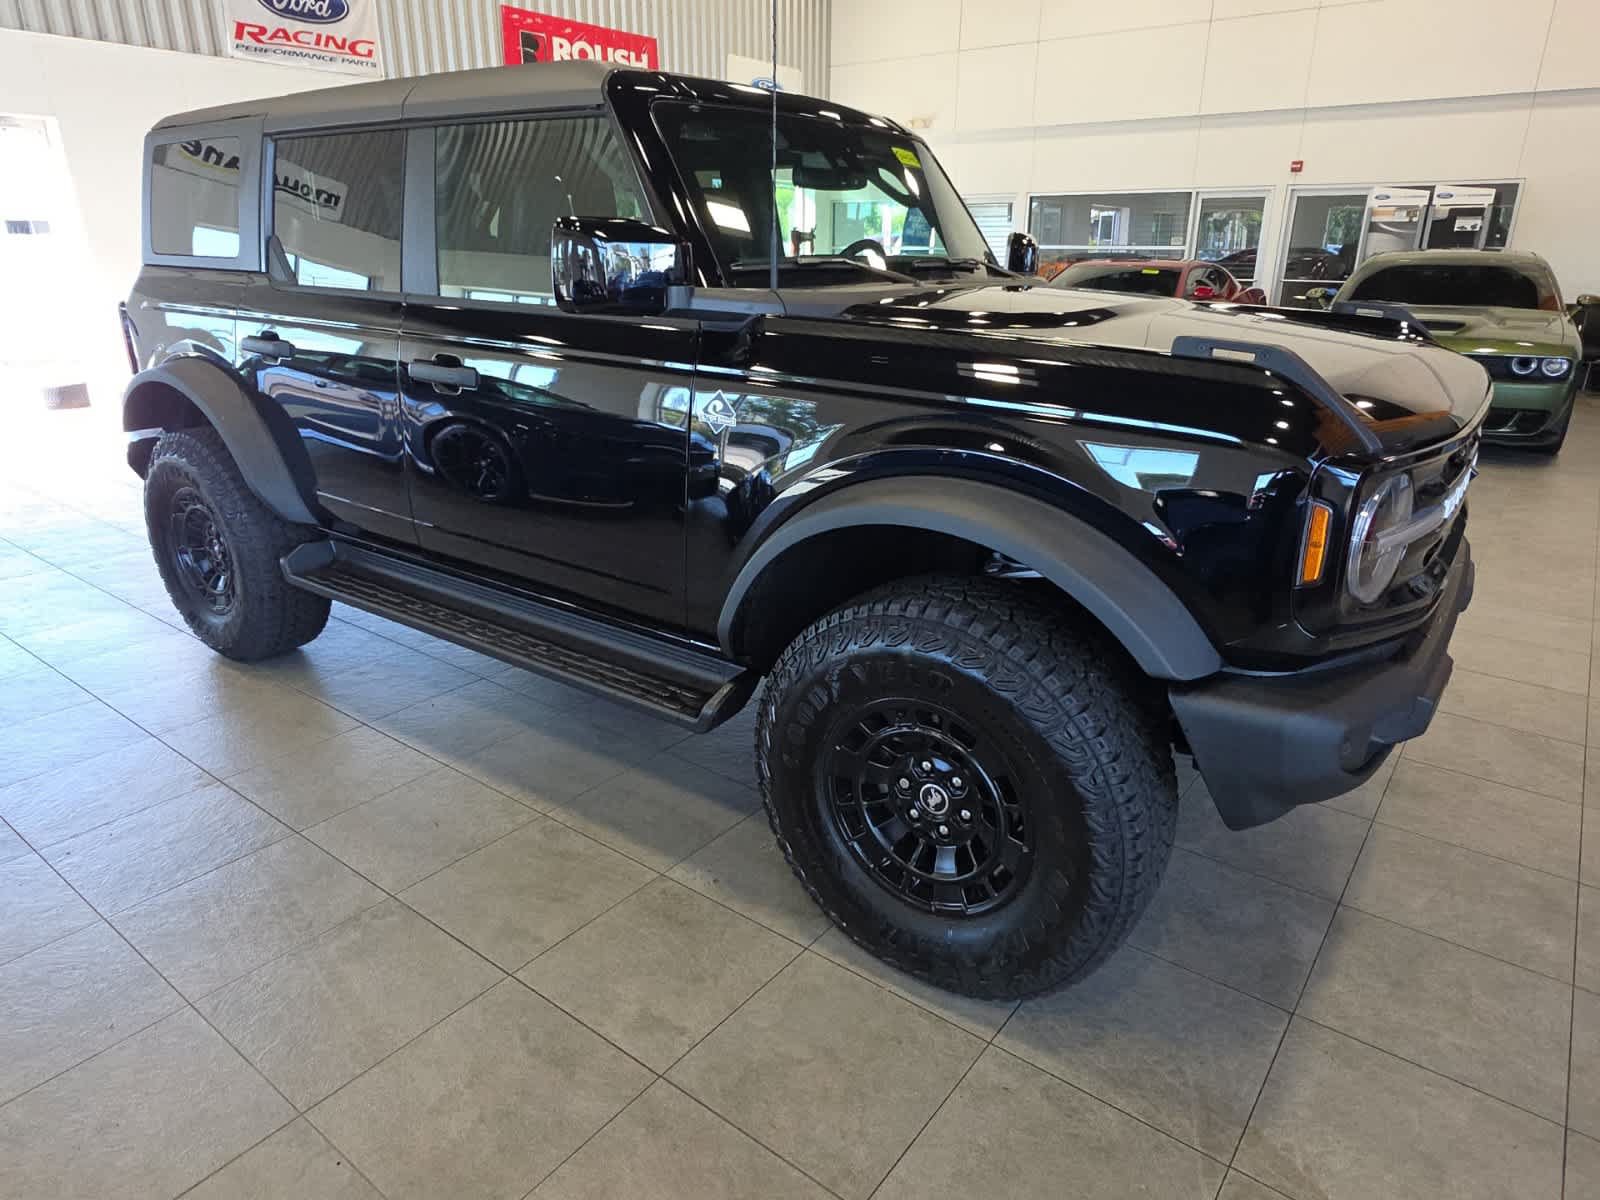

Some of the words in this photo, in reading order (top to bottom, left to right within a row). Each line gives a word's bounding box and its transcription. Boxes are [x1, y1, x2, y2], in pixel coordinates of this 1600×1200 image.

[233, 20, 375, 58] RACING
[235, 43, 338, 62] PERFORMANCE
[341, 58, 377, 68] PARTS
[552, 36, 649, 69] ROUSH
